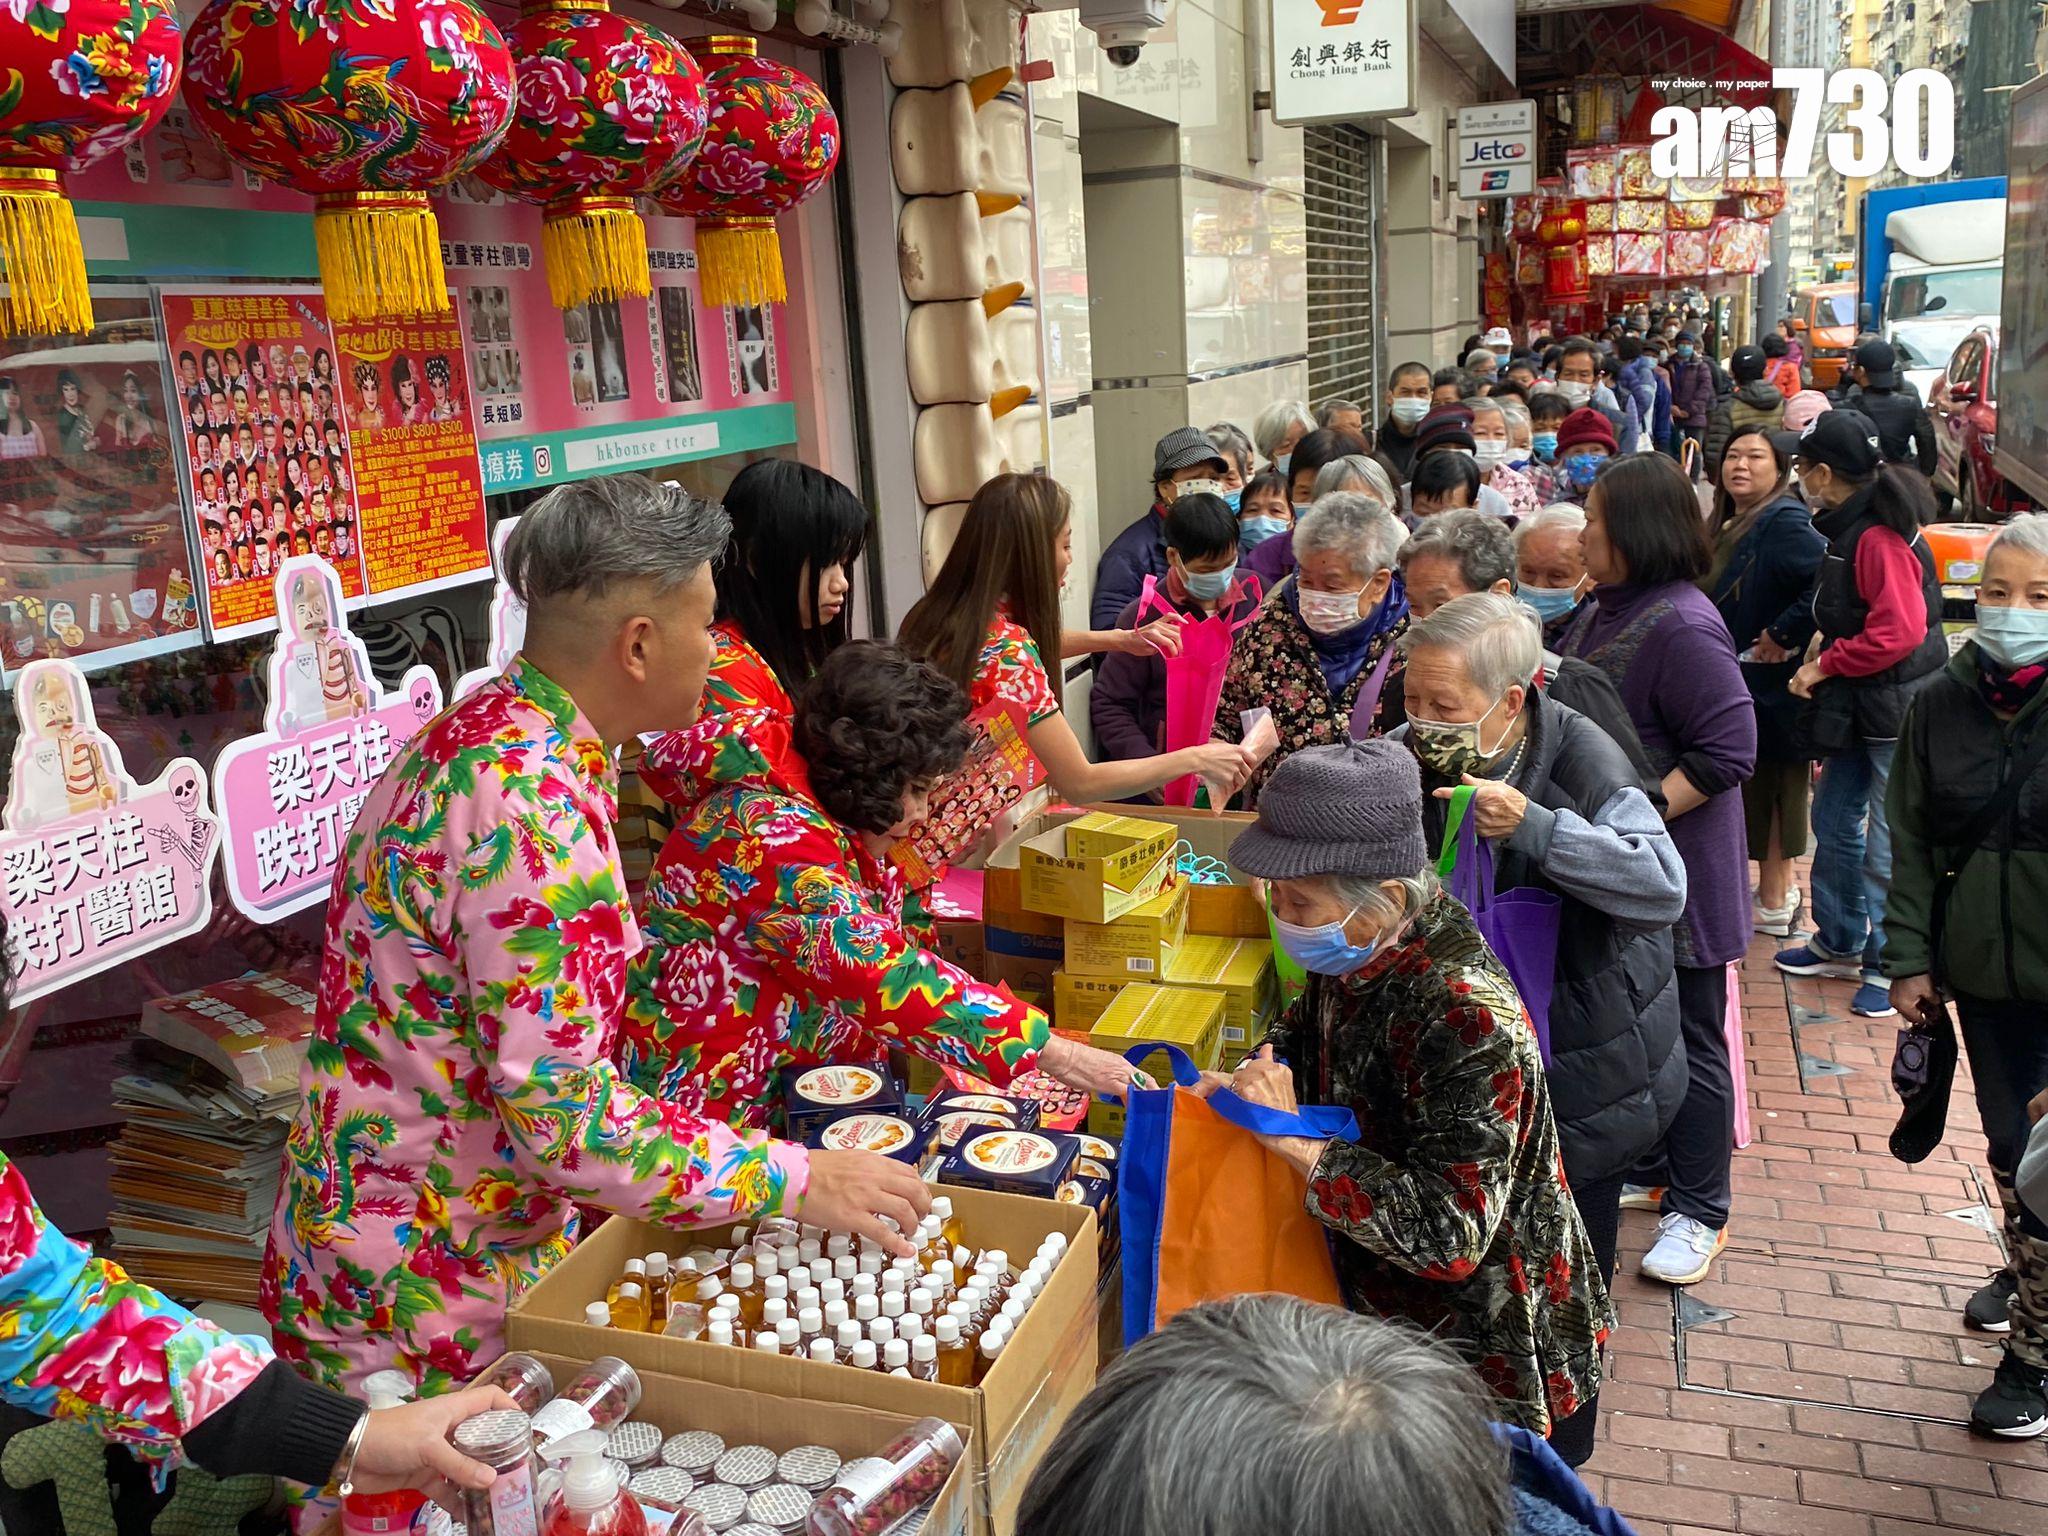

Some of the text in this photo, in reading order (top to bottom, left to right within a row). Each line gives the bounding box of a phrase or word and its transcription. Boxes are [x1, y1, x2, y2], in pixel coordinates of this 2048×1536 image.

[1290, 38, 1392, 68] 創興銀行
[1290, 61, 1392, 79] Chong Hing Bank
[1465, 140, 1526, 163] Jetco
[483, 402, 523, 425] 長短腳
[381, 426, 411, 442] $1000
[412, 423, 437, 438] $800
[439, 420, 463, 435] $500
[266, 719, 392, 815] 梁天柱
[3, 810, 149, 909] 梁天柱
[1074, 980, 1126, 993] 麝香壮骨
